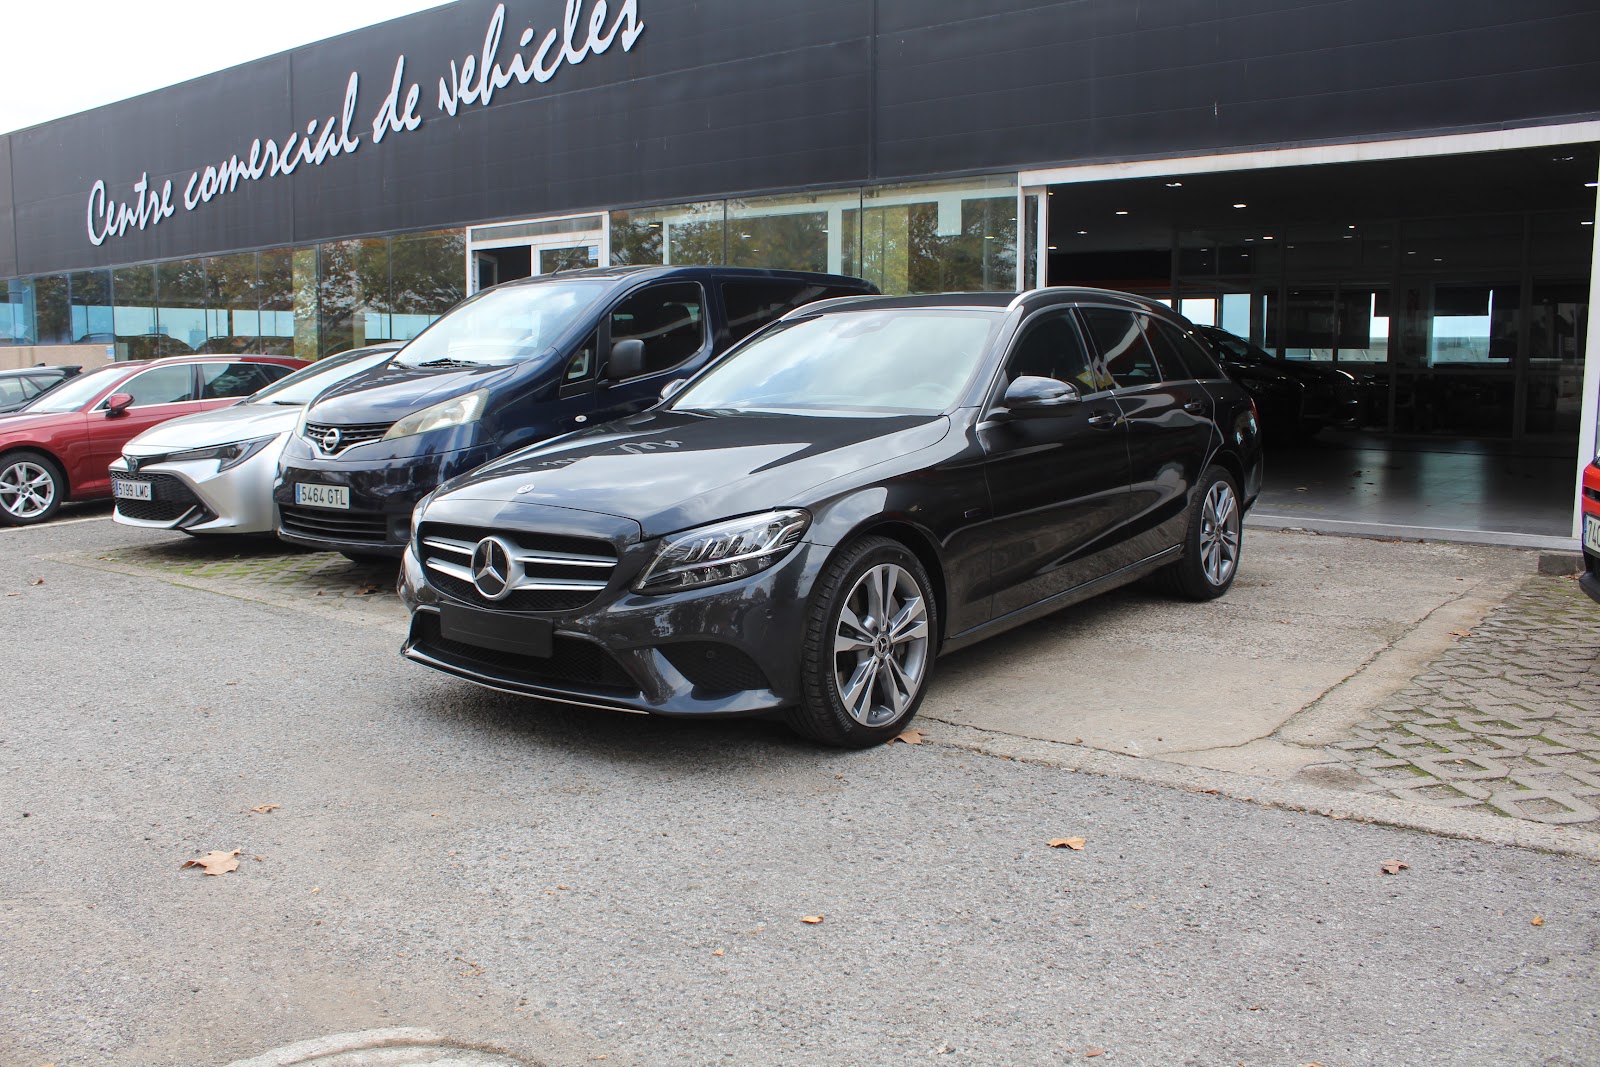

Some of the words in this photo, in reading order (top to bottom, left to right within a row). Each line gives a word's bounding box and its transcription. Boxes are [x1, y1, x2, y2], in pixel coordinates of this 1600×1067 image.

[87, 171, 175, 246] Centre
[184, 71, 359, 211] comercial
[372, 54, 421, 143] de
[438, 0, 645, 117] vehicles
[118, 482, 134, 497] 5199
[135, 485, 149, 498] LMC
[301, 486, 325, 503] 5464
[327, 488, 347, 506] GTL
[825, 671, 853, 732] BRIDGESTONE
